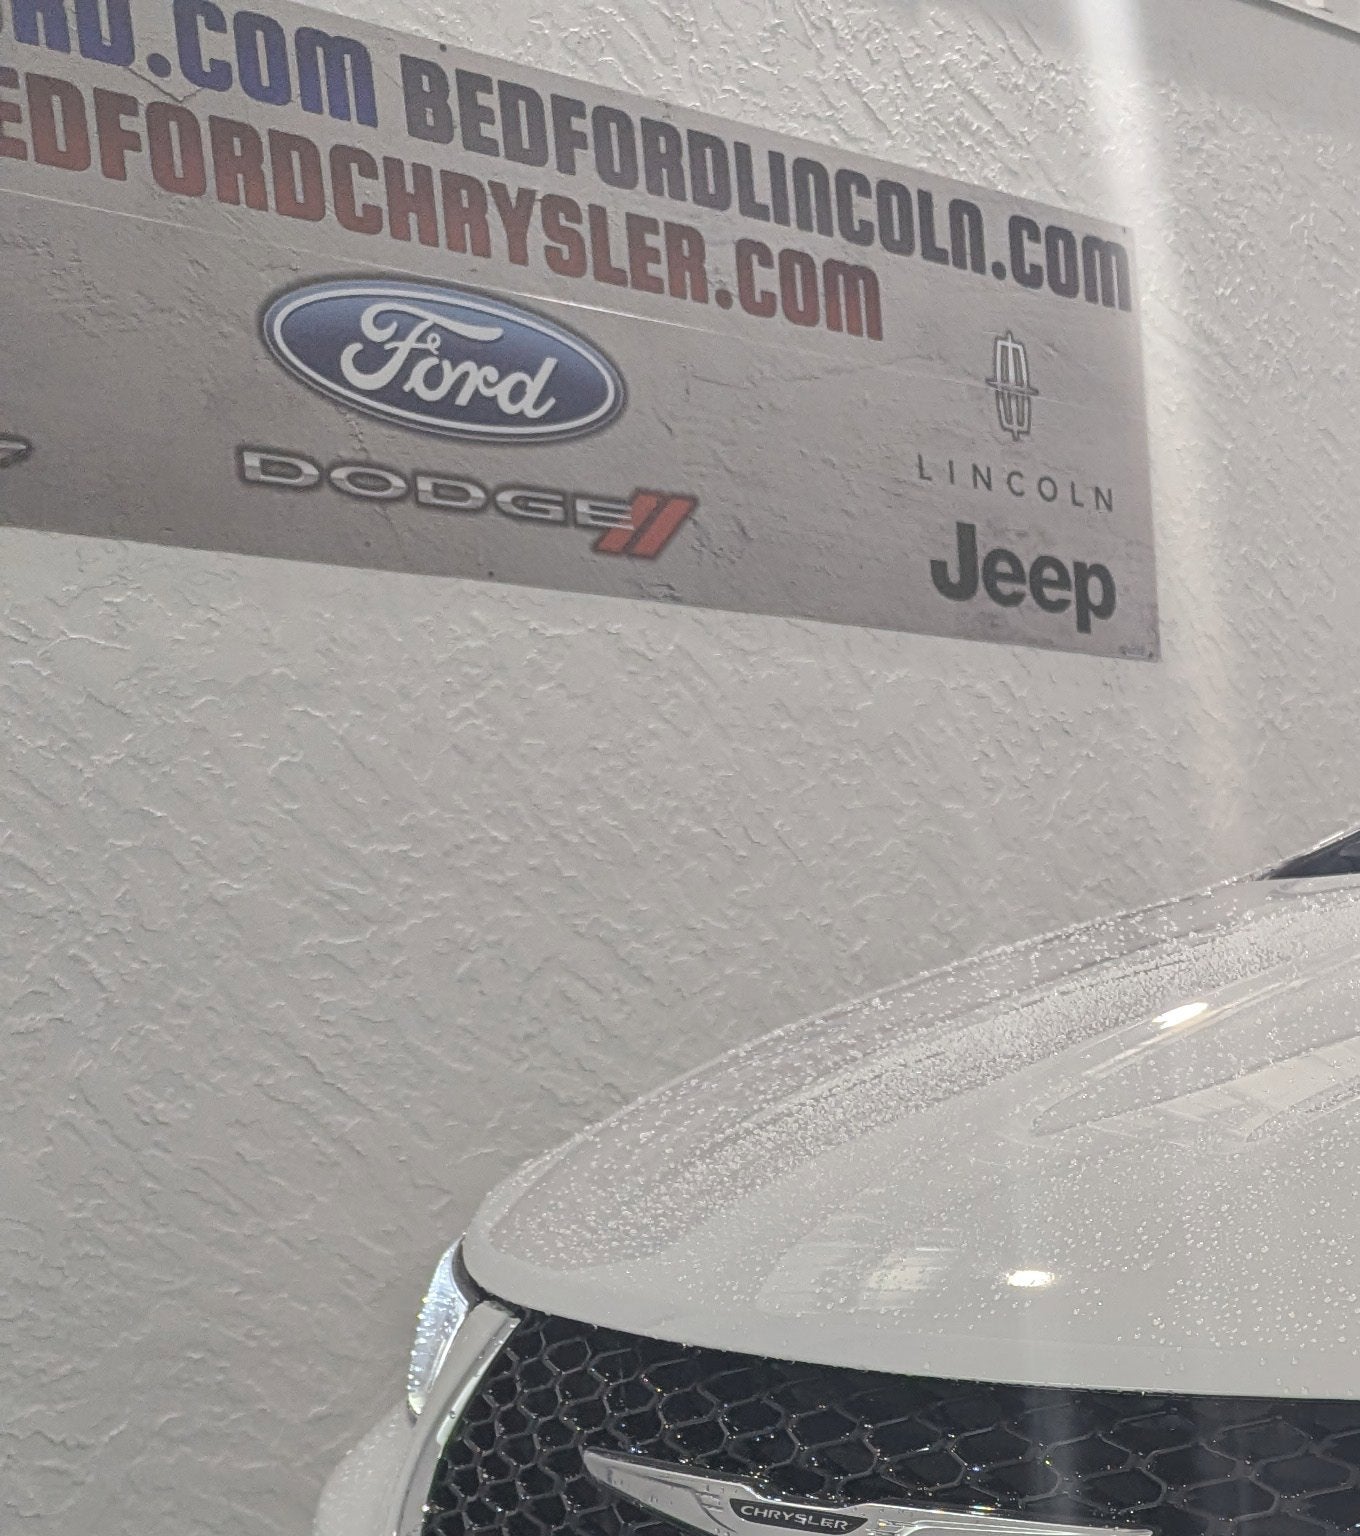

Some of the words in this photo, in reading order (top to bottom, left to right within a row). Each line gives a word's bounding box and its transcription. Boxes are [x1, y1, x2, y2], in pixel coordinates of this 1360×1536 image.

[400, 53, 1132, 312] BEDFORDLINCOLN.COM
[340, 302, 558, 419] Ford
[240, 448, 635, 531] DODGE
[918, 453, 1114, 513] LINCOLN
[930, 521, 1117, 634] Jeep
[740, 1505, 849, 1531] CHRYSLER
